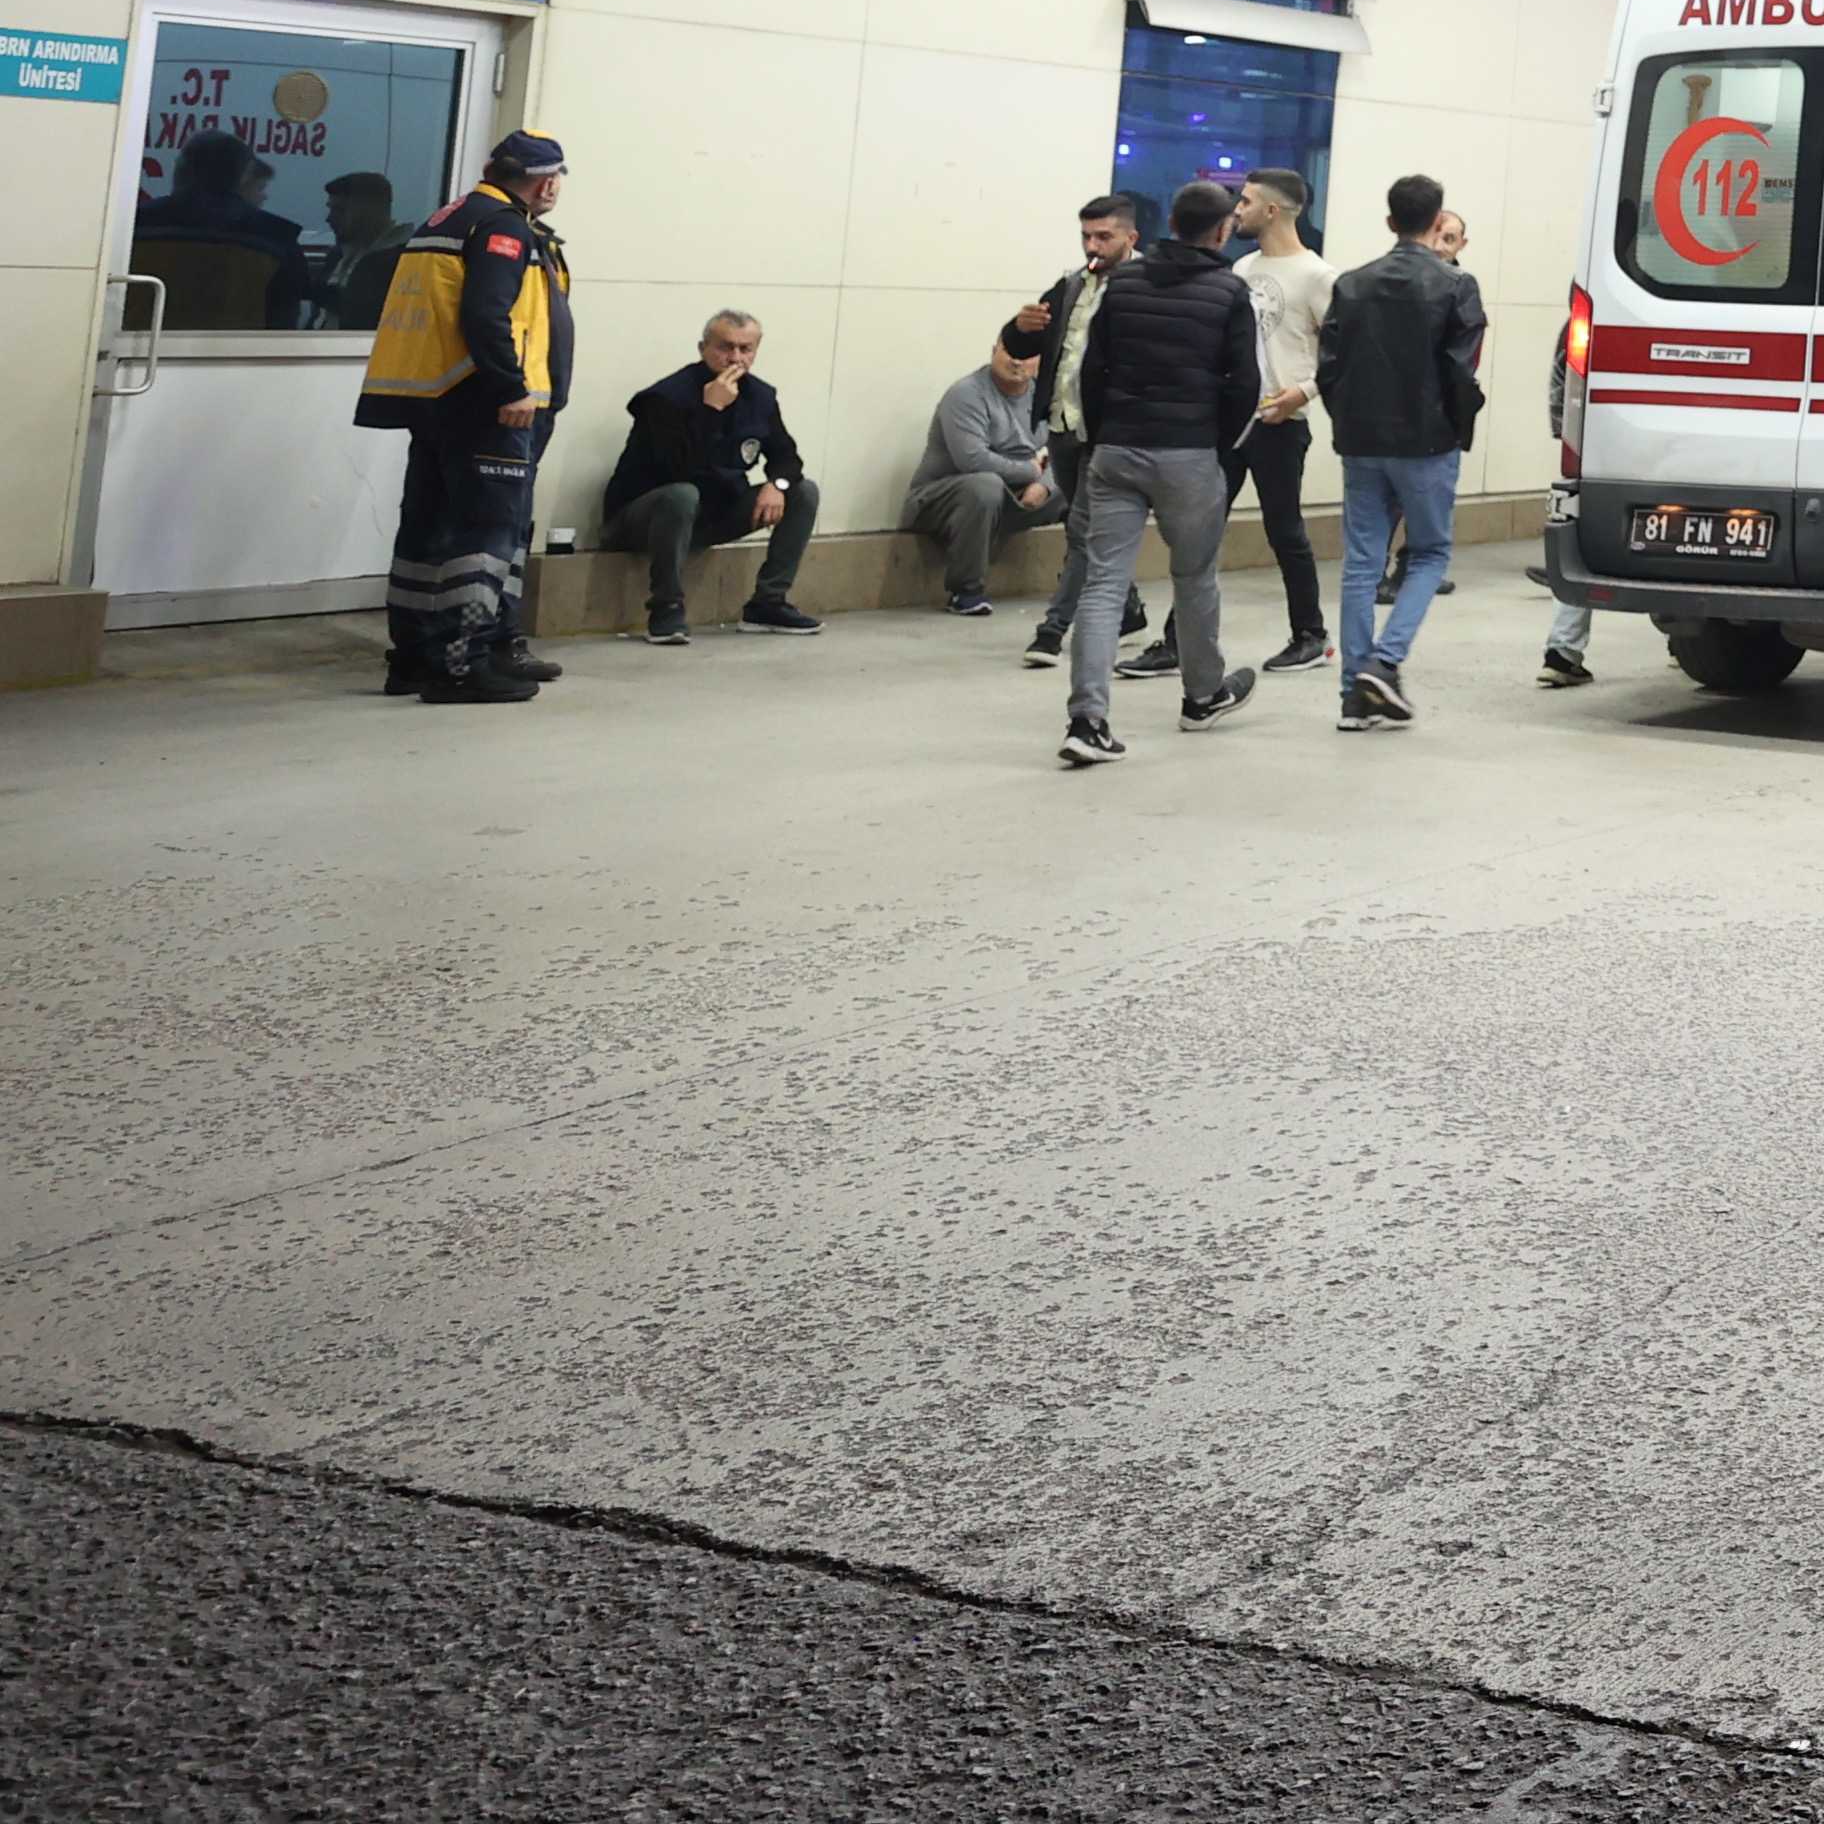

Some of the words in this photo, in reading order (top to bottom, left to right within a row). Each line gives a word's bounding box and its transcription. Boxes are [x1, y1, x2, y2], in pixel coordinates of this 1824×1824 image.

[32, 39, 119, 65] ARINDIRMA
[1692, 159, 1759, 217] 112
[1652, 346, 1748, 361] TRANSIT
[1644, 514, 1669, 541] 81
[1683, 516, 1713, 543] FN
[1725, 518, 1767, 546] 941
